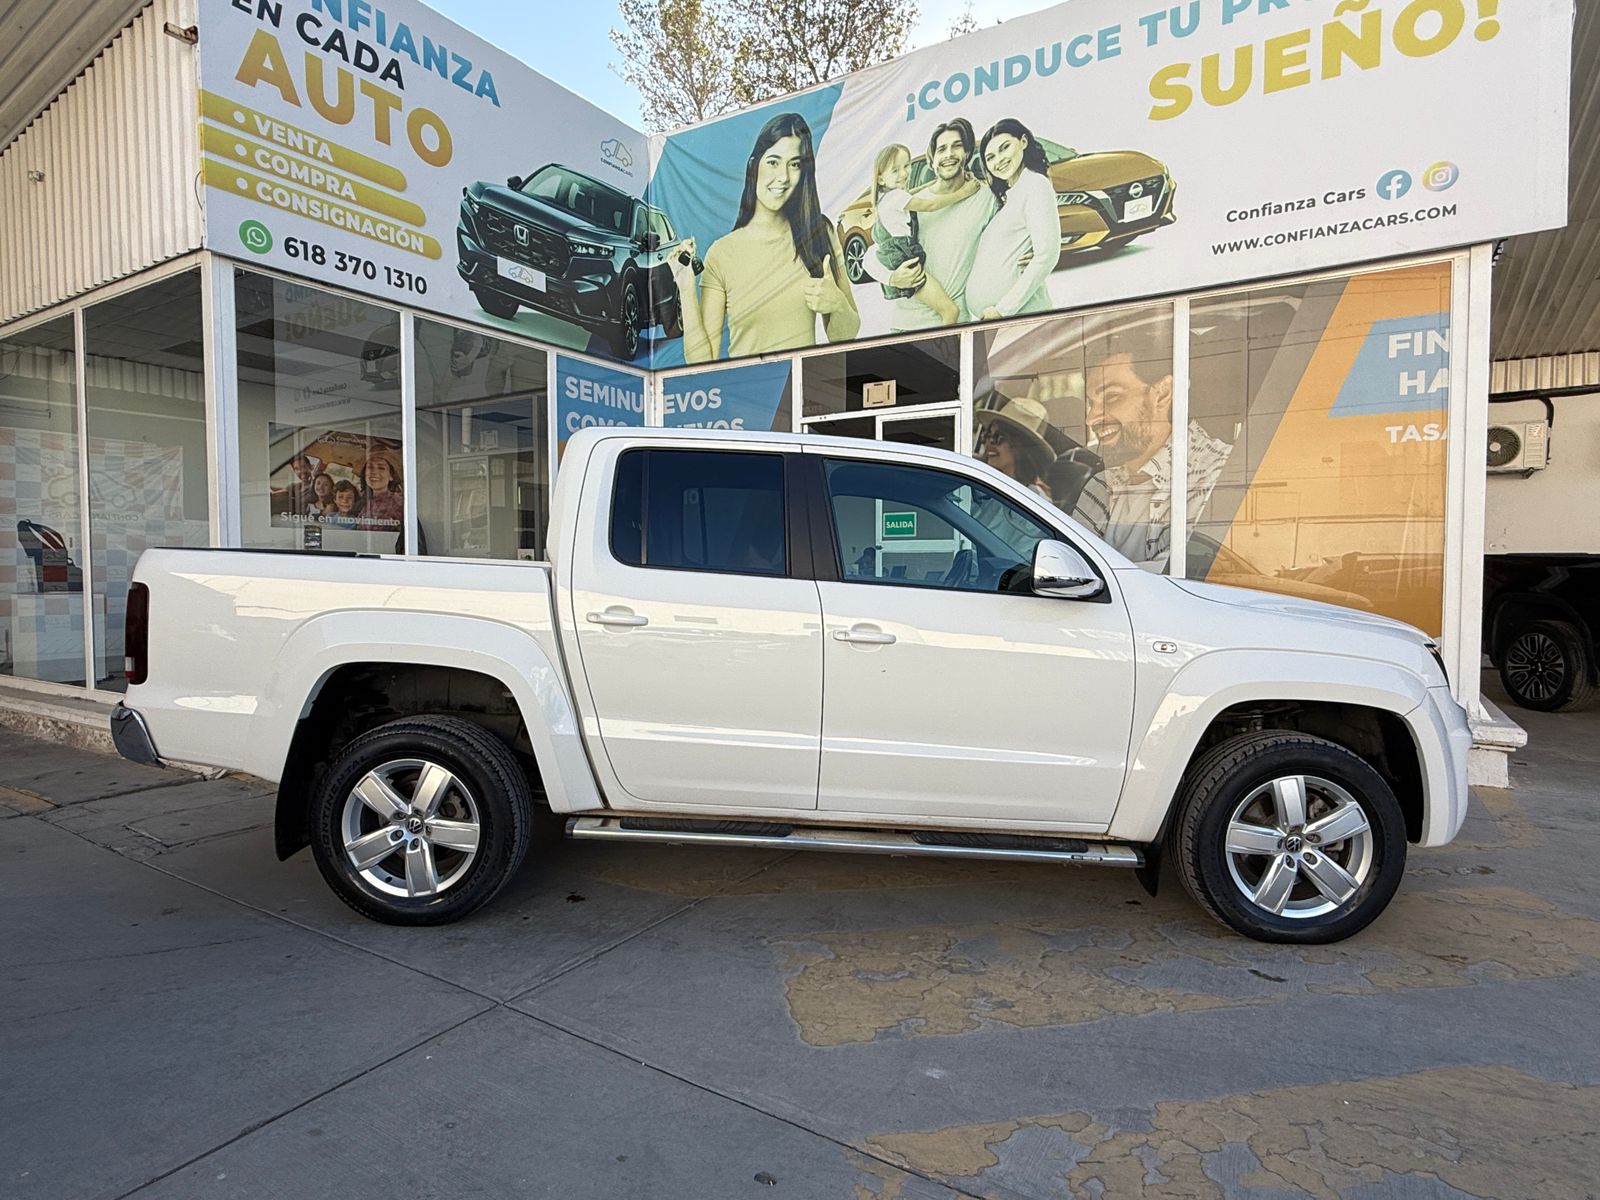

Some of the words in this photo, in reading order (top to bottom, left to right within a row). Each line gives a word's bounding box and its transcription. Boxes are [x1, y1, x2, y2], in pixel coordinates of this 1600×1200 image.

[296, 12, 405, 91] CADA
[904, 24, 1122, 121] ¡CONDUCE
[1138, 0, 1201, 47] TU
[1147, 0, 1501, 121] SUEÑO!
[234, 28, 453, 168] AUTO
[252, 114, 335, 163] VENTA
[254, 148, 358, 201] COMPRA
[256, 181, 425, 254] CONSIGNACIÓN
[1211, 203, 1458, 255] WWW.CONFIANZACARS.COM
[1226, 197, 1317, 223] Confianza
[1323, 187, 1367, 206] Cars
[283, 236, 327, 266] 618
[334, 250, 377, 280] 370
[383, 265, 428, 295] 1310
[281, 511, 315, 525] Sigue
[318, 514, 334, 524] en
[336, 516, 401, 527] movimiento
[886, 520, 914, 529] SALIDA
